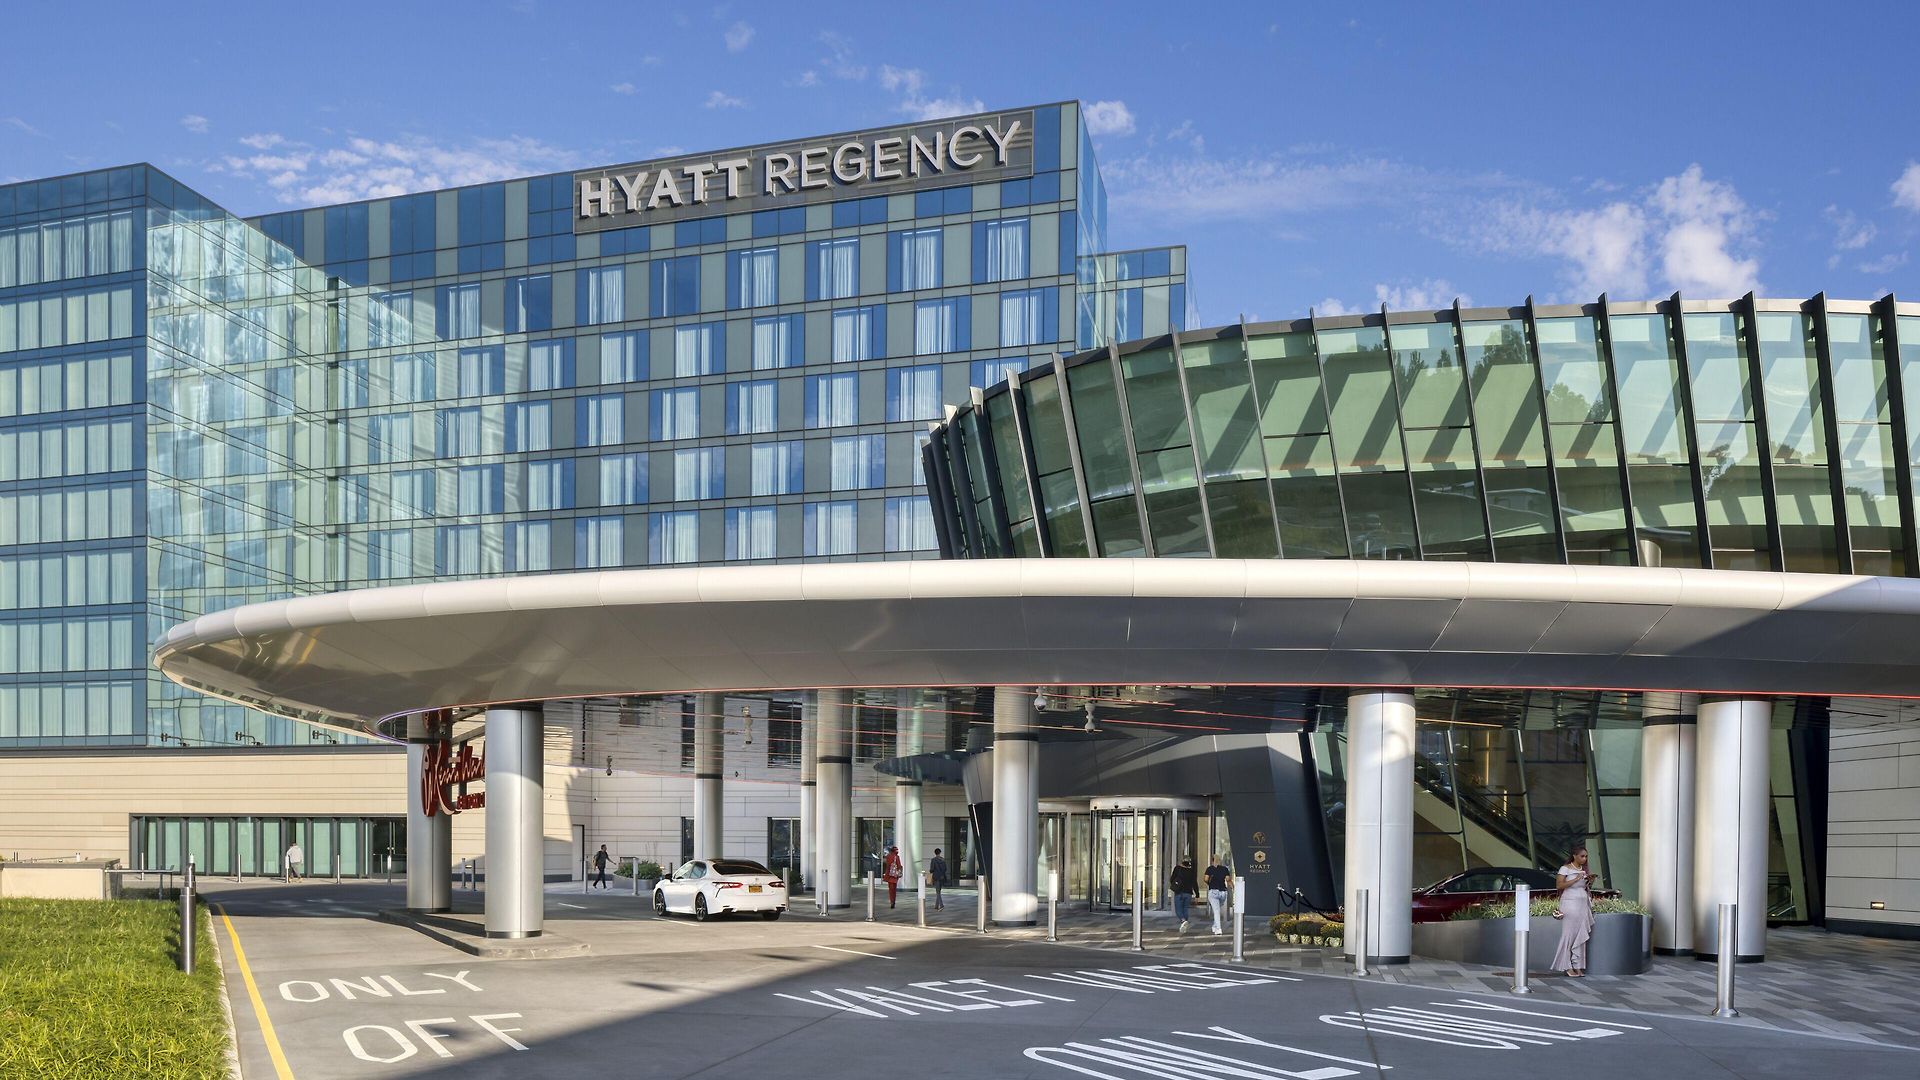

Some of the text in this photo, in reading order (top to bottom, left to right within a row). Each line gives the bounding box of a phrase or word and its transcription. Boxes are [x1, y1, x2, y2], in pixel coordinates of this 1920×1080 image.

[580, 121, 1020, 217] HYATT REGENCY
[278, 970, 484, 1003] ONLY
[773, 978, 1076, 1018] VALET
[1023, 963, 1303, 993] VALET
[342, 1012, 530, 1064] OFF
[1318, 998, 1653, 1049] ONLY
